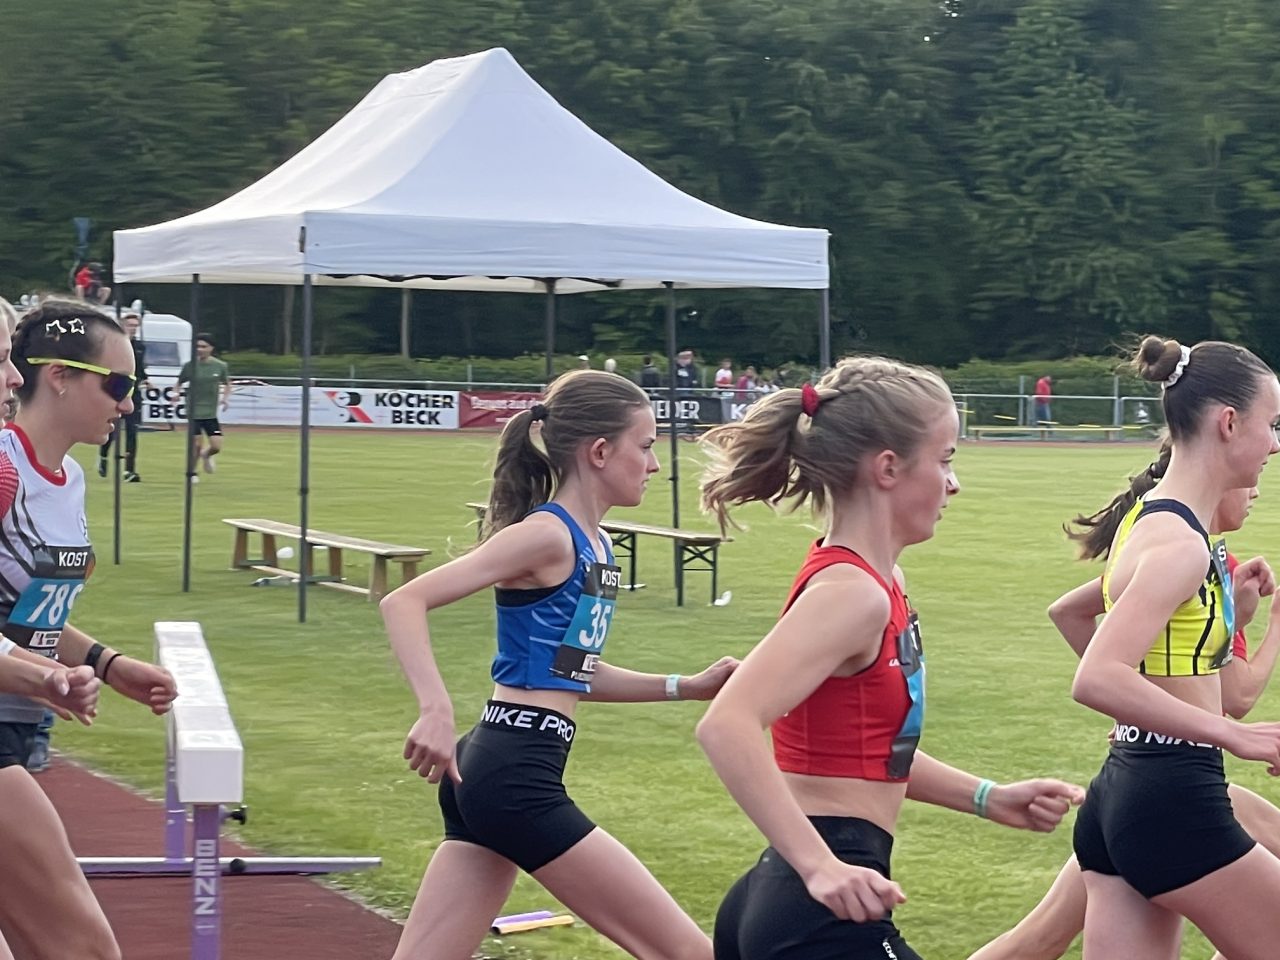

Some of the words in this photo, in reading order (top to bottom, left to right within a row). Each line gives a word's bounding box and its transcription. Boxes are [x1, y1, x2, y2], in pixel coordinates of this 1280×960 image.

[375, 392, 454, 409] KOCHER
[150, 404, 187, 419] BEC
[392, 410, 441, 425] BECK
[58, 551, 88, 567] KOST
[601, 569, 621, 587] KOST
[481, 704, 539, 729] NIKE
[539, 714, 574, 742] PRO
